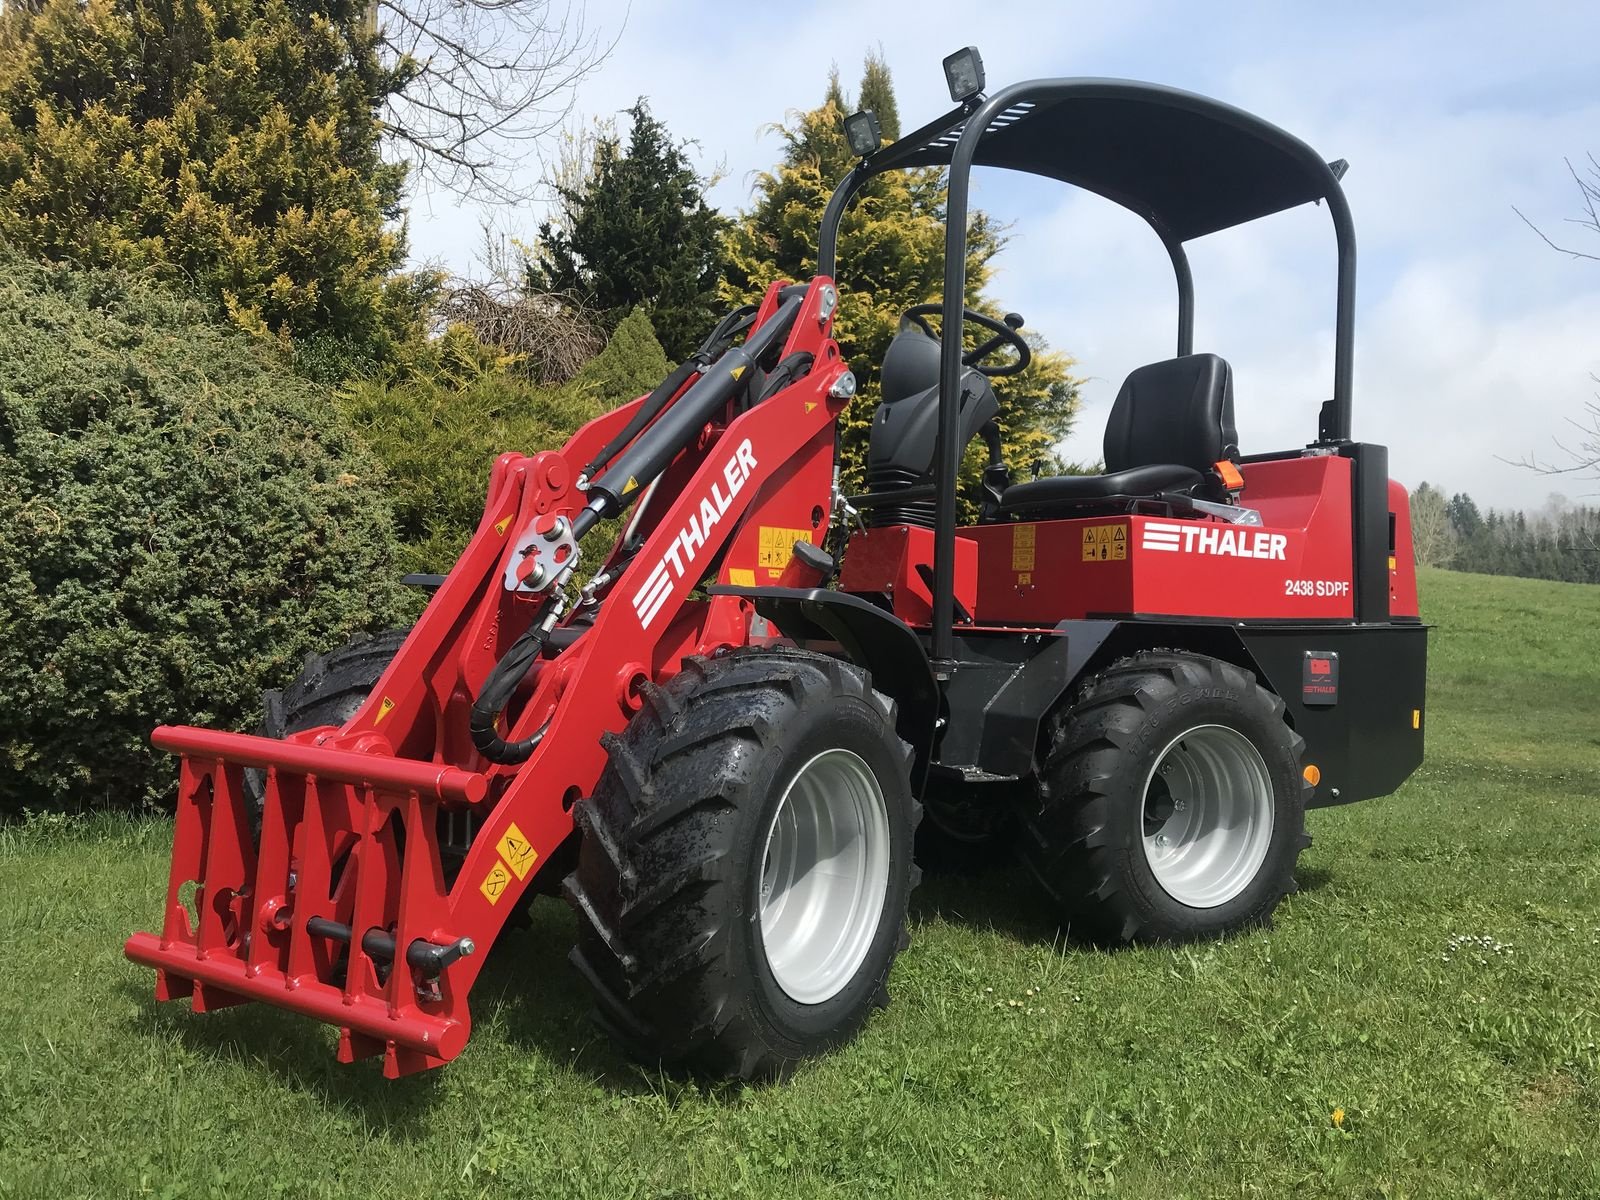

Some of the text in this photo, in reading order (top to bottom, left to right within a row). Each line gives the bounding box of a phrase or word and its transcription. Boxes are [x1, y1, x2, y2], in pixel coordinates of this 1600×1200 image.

[663, 438, 758, 578] THALER
[1181, 525, 1287, 560] THALER
[1285, 580, 1349, 596] 2438 SDPF
